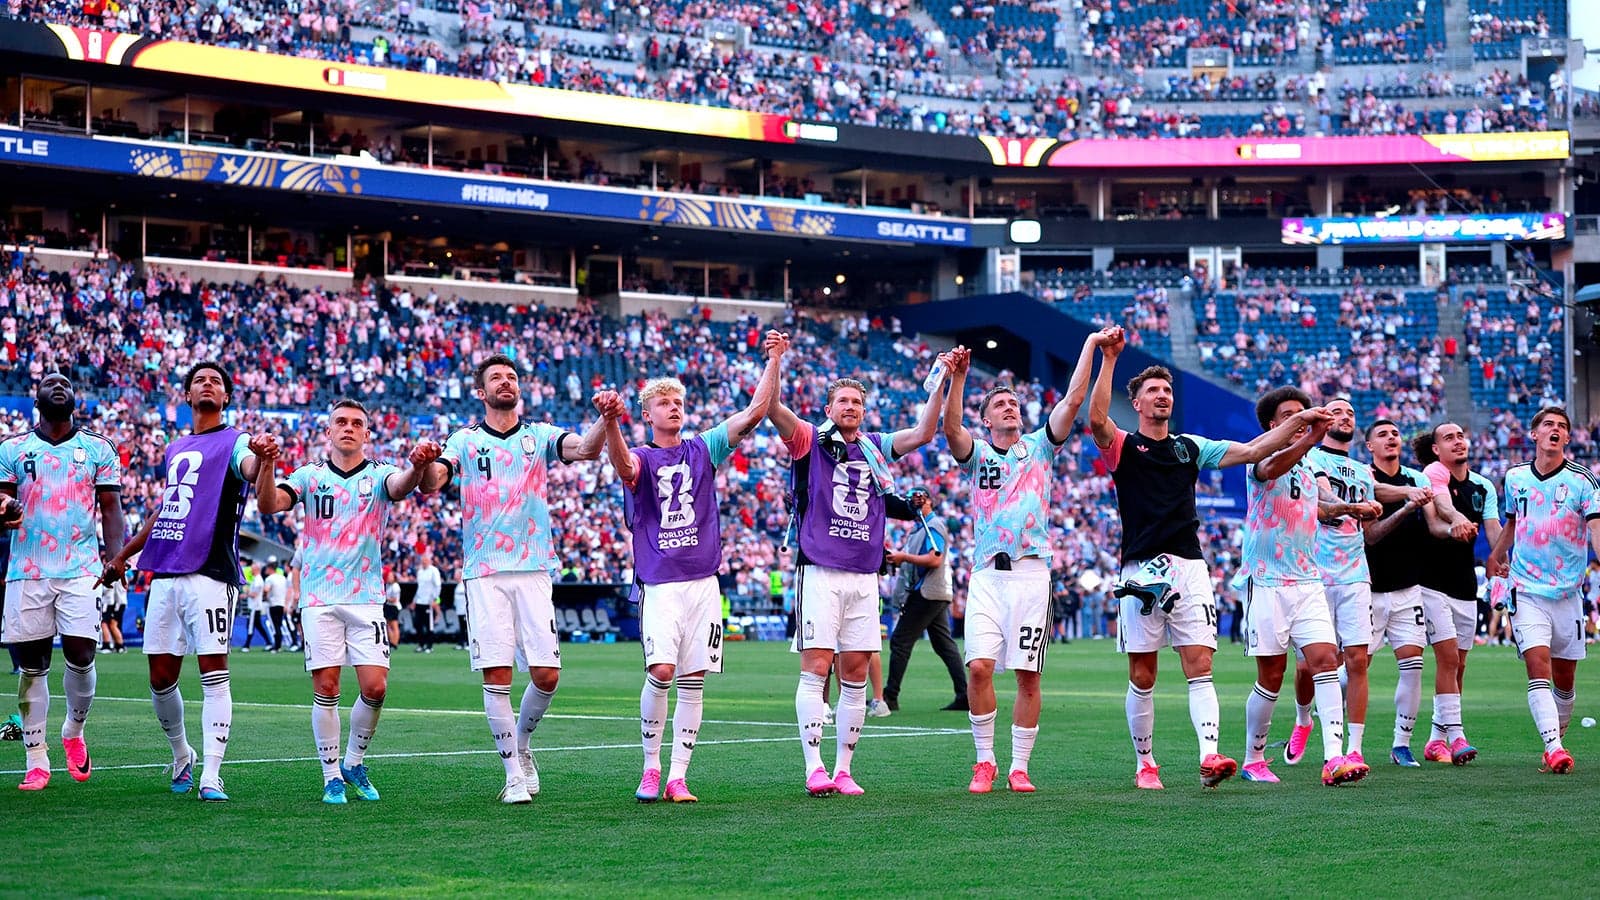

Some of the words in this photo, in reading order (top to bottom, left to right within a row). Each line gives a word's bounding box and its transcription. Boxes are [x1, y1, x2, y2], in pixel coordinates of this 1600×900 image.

[0, 136, 49, 157] TLE
[461, 184, 549, 210] #FIFAWorldCup
[878, 221, 965, 241] SEATTLE
[24, 460, 37, 482] 9
[478, 457, 491, 481] 4
[979, 466, 1001, 489] 22
[1290, 477, 1301, 500] 6
[314, 494, 335, 520] 10
[668, 513, 686, 523] FIFA
[831, 518, 857, 528] WORLD
[151, 529, 184, 541] 2026
[658, 530, 683, 539] WORLD
[658, 535, 698, 550] 2026
[829, 526, 870, 541] 2026
[205, 608, 227, 634] 16
[1413, 606, 1424, 626] 2
[708, 622, 721, 649] 18
[1019, 626, 1043, 651] 22
